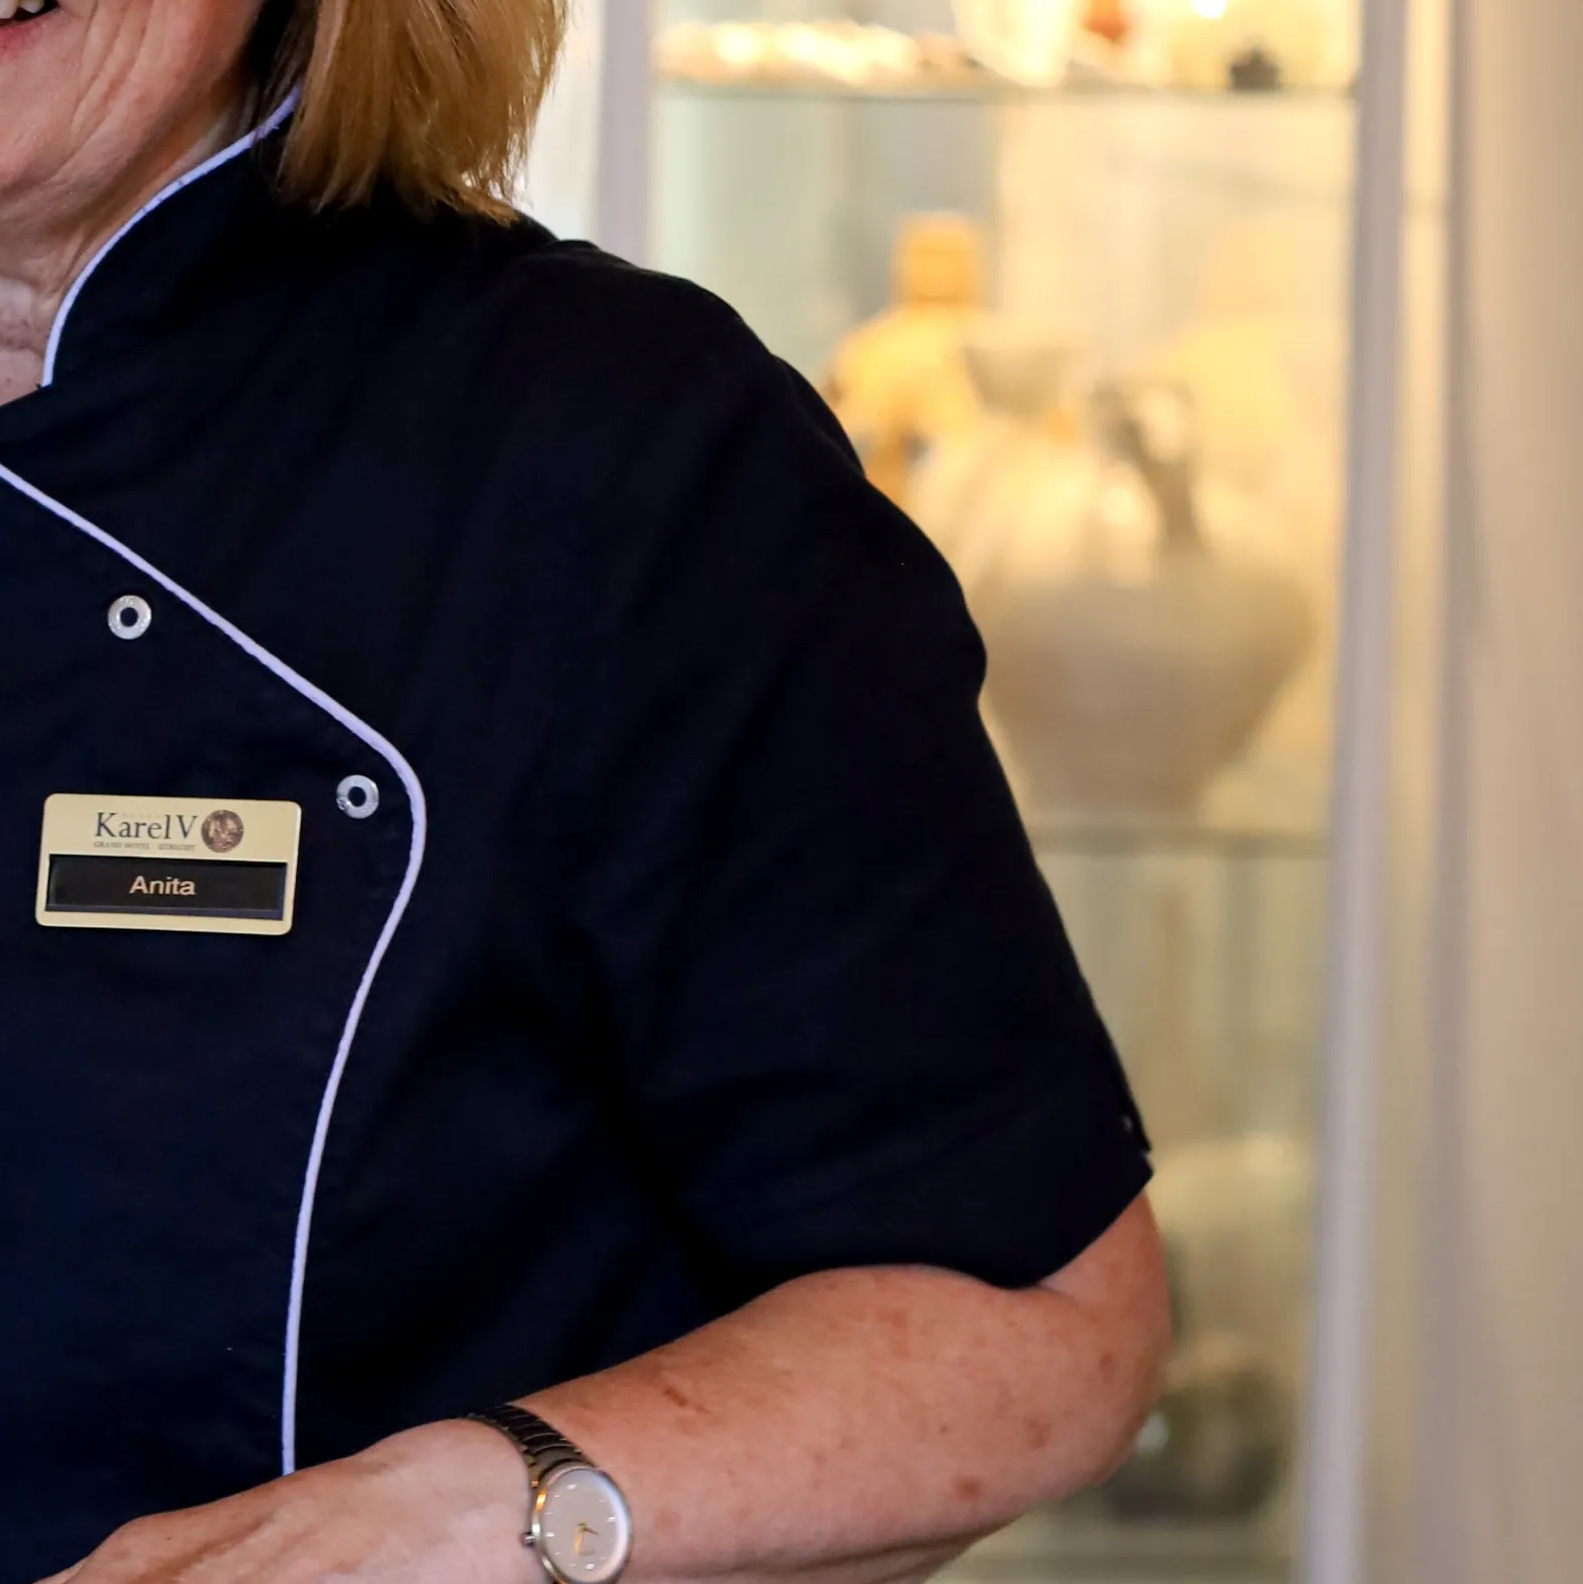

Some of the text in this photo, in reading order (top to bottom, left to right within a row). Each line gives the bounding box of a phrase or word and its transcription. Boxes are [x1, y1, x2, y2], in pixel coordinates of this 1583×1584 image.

[94, 811, 199, 840] Karel V
[129, 875, 197, 896] Anita
